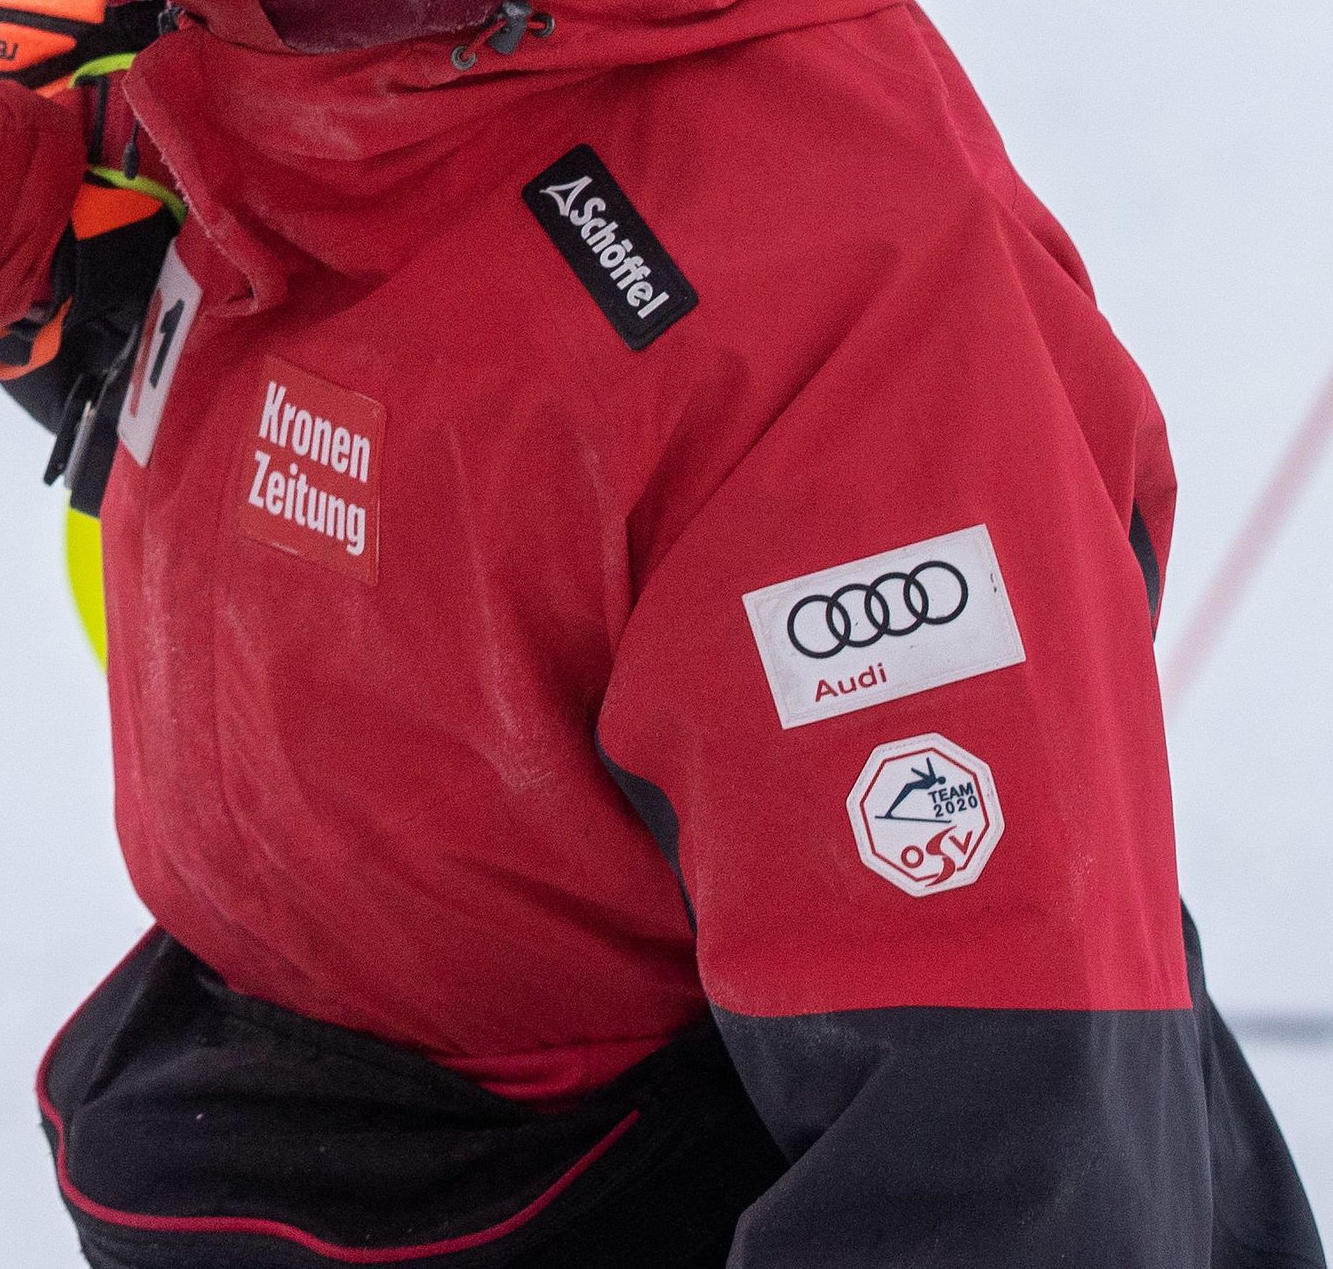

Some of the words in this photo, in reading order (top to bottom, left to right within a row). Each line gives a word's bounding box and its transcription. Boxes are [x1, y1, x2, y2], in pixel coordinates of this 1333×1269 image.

[569, 196, 670, 320] Schöffel
[257, 380, 372, 484] Kronen
[247, 449, 367, 557] Zeitung
[814, 662, 889, 703] Audi
[927, 781, 975, 804] TEAM
[933, 795, 979, 818] 2020
